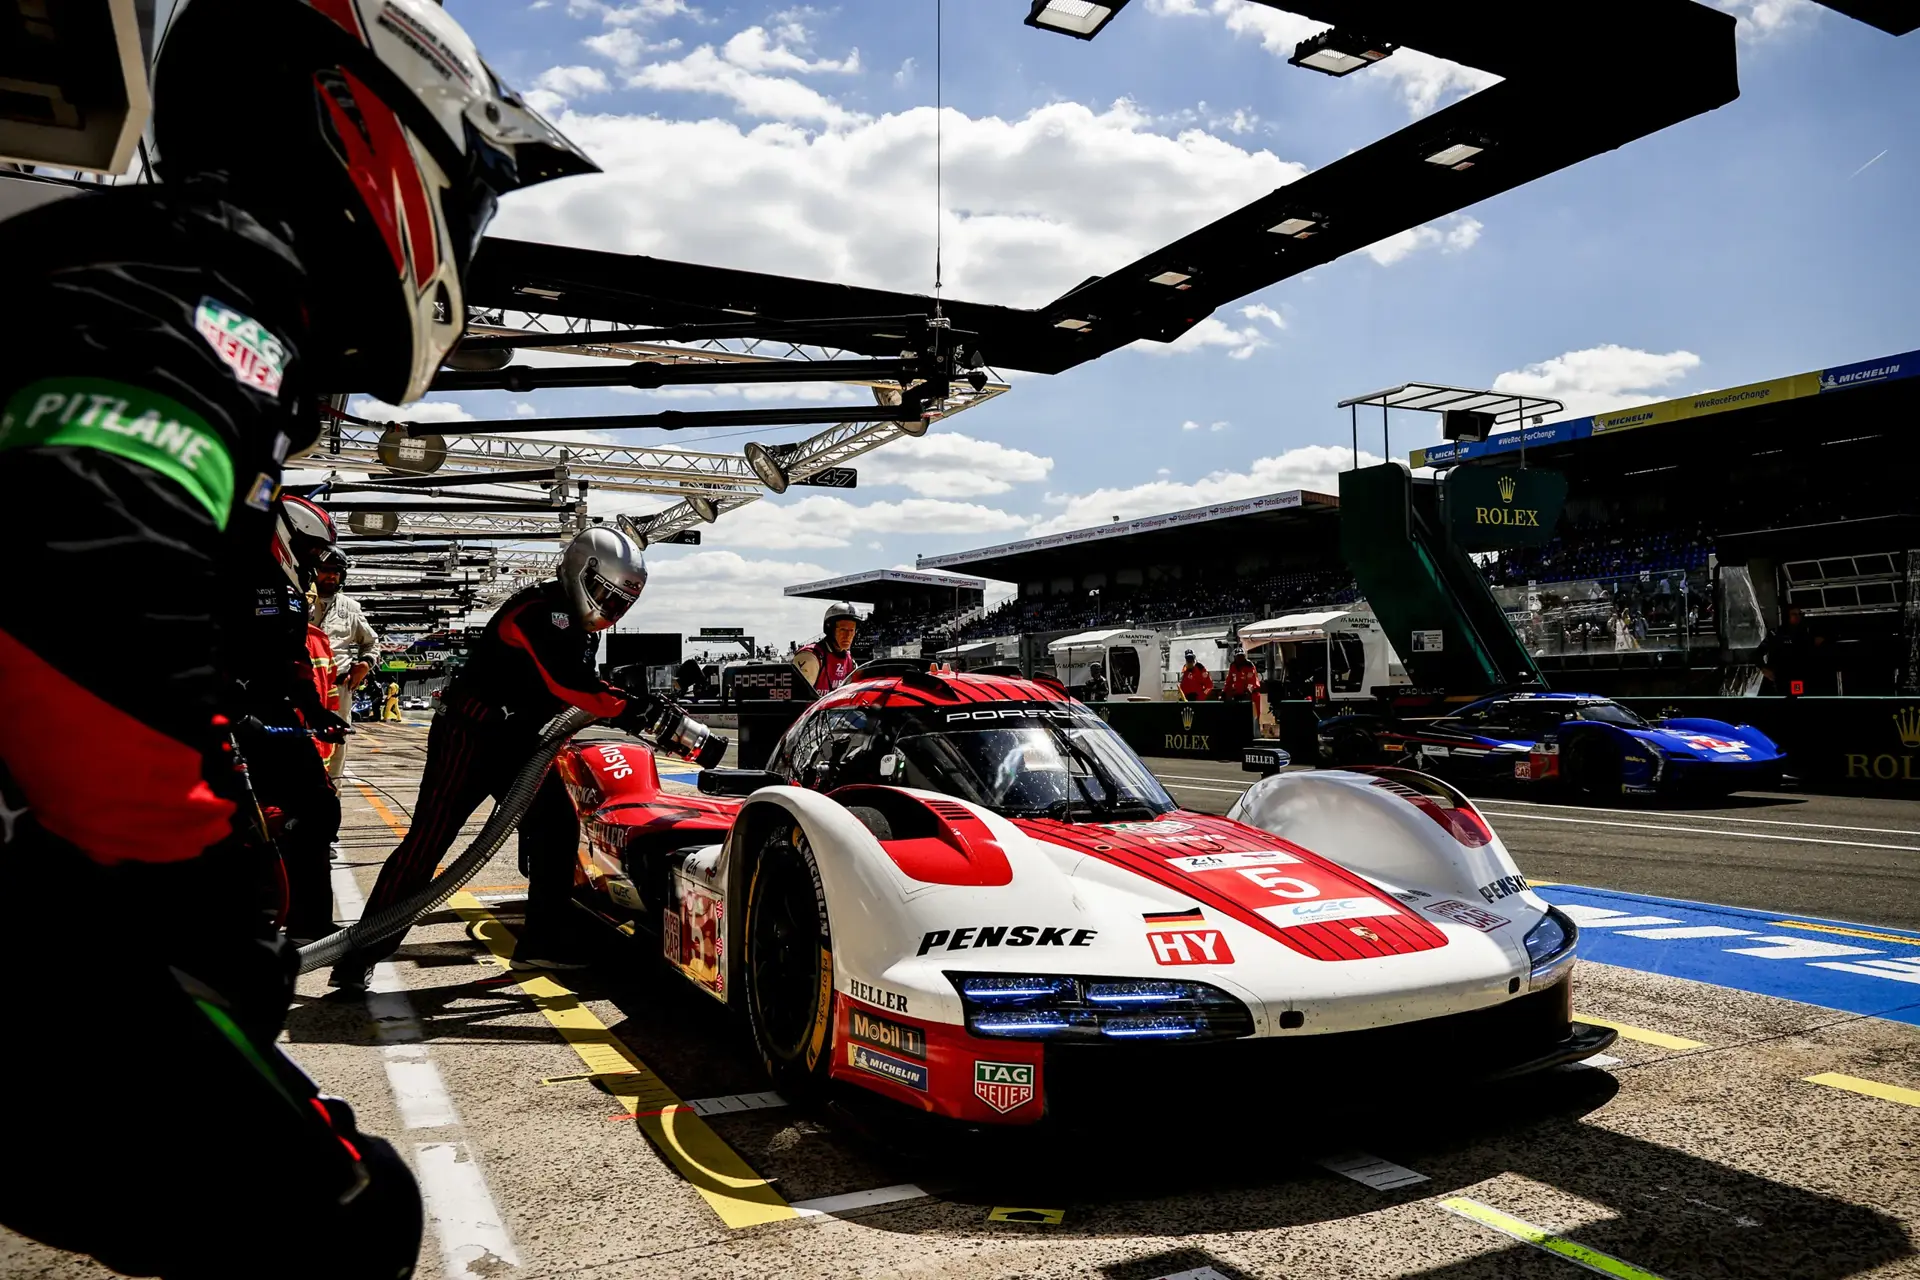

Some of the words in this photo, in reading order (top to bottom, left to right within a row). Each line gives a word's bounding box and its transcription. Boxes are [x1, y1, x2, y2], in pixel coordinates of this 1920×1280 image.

[212, 305, 284, 366] TAG
[1839, 364, 1900, 384] MICHELIN
[1694, 387, 1770, 409] #WeRaceForChange
[1608, 411, 1653, 426] MICHELIN
[25, 393, 212, 470] PITLANE
[1434, 446, 1470, 460] MICHLIN
[816, 469, 856, 486] 47
[1264, 494, 1299, 507] TotalEnergies
[1178, 510, 1207, 522] TotalEnergies
[1219, 503, 1251, 515] TotalEnergies
[1475, 506, 1540, 527] ROLEX
[1104, 524, 1130, 535] TotalEnergies
[1140, 518, 1167, 529] TotalEnergies
[901, 573, 932, 582] TotalEnergies
[948, 578, 979, 587] TotalEnergies
[427, 652, 440, 660] 94
[734, 672, 793, 688] PORSCHE
[769, 688, 792, 700] 963
[1315, 685, 1325, 698] HY
[1399, 687, 1445, 696] CADILLAC
[946, 709, 1102, 724] PORSCHE
[1164, 734, 1210, 750] ROLEX
[1245, 754, 1275, 765] HELLER
[1516, 767, 1530, 777] CAR
[1236, 867, 1320, 899] 5
[803, 845, 829, 938] MICHELIN
[1292, 900, 1357, 915] WEC
[1453, 909, 1503, 929] CAR
[665, 929, 680, 962] CAR
[916, 925, 1098, 957] PENSKE
[1151, 931, 1218, 963] HY
[851, 979, 909, 1014] HELLER
[854, 1013, 900, 1049] Mobil
[906, 1031, 914, 1050] 1
[869, 1058, 920, 1083] MICHELIN
[979, 1065, 1028, 1083] TAG
[978, 1083, 1029, 1109] HEUER
